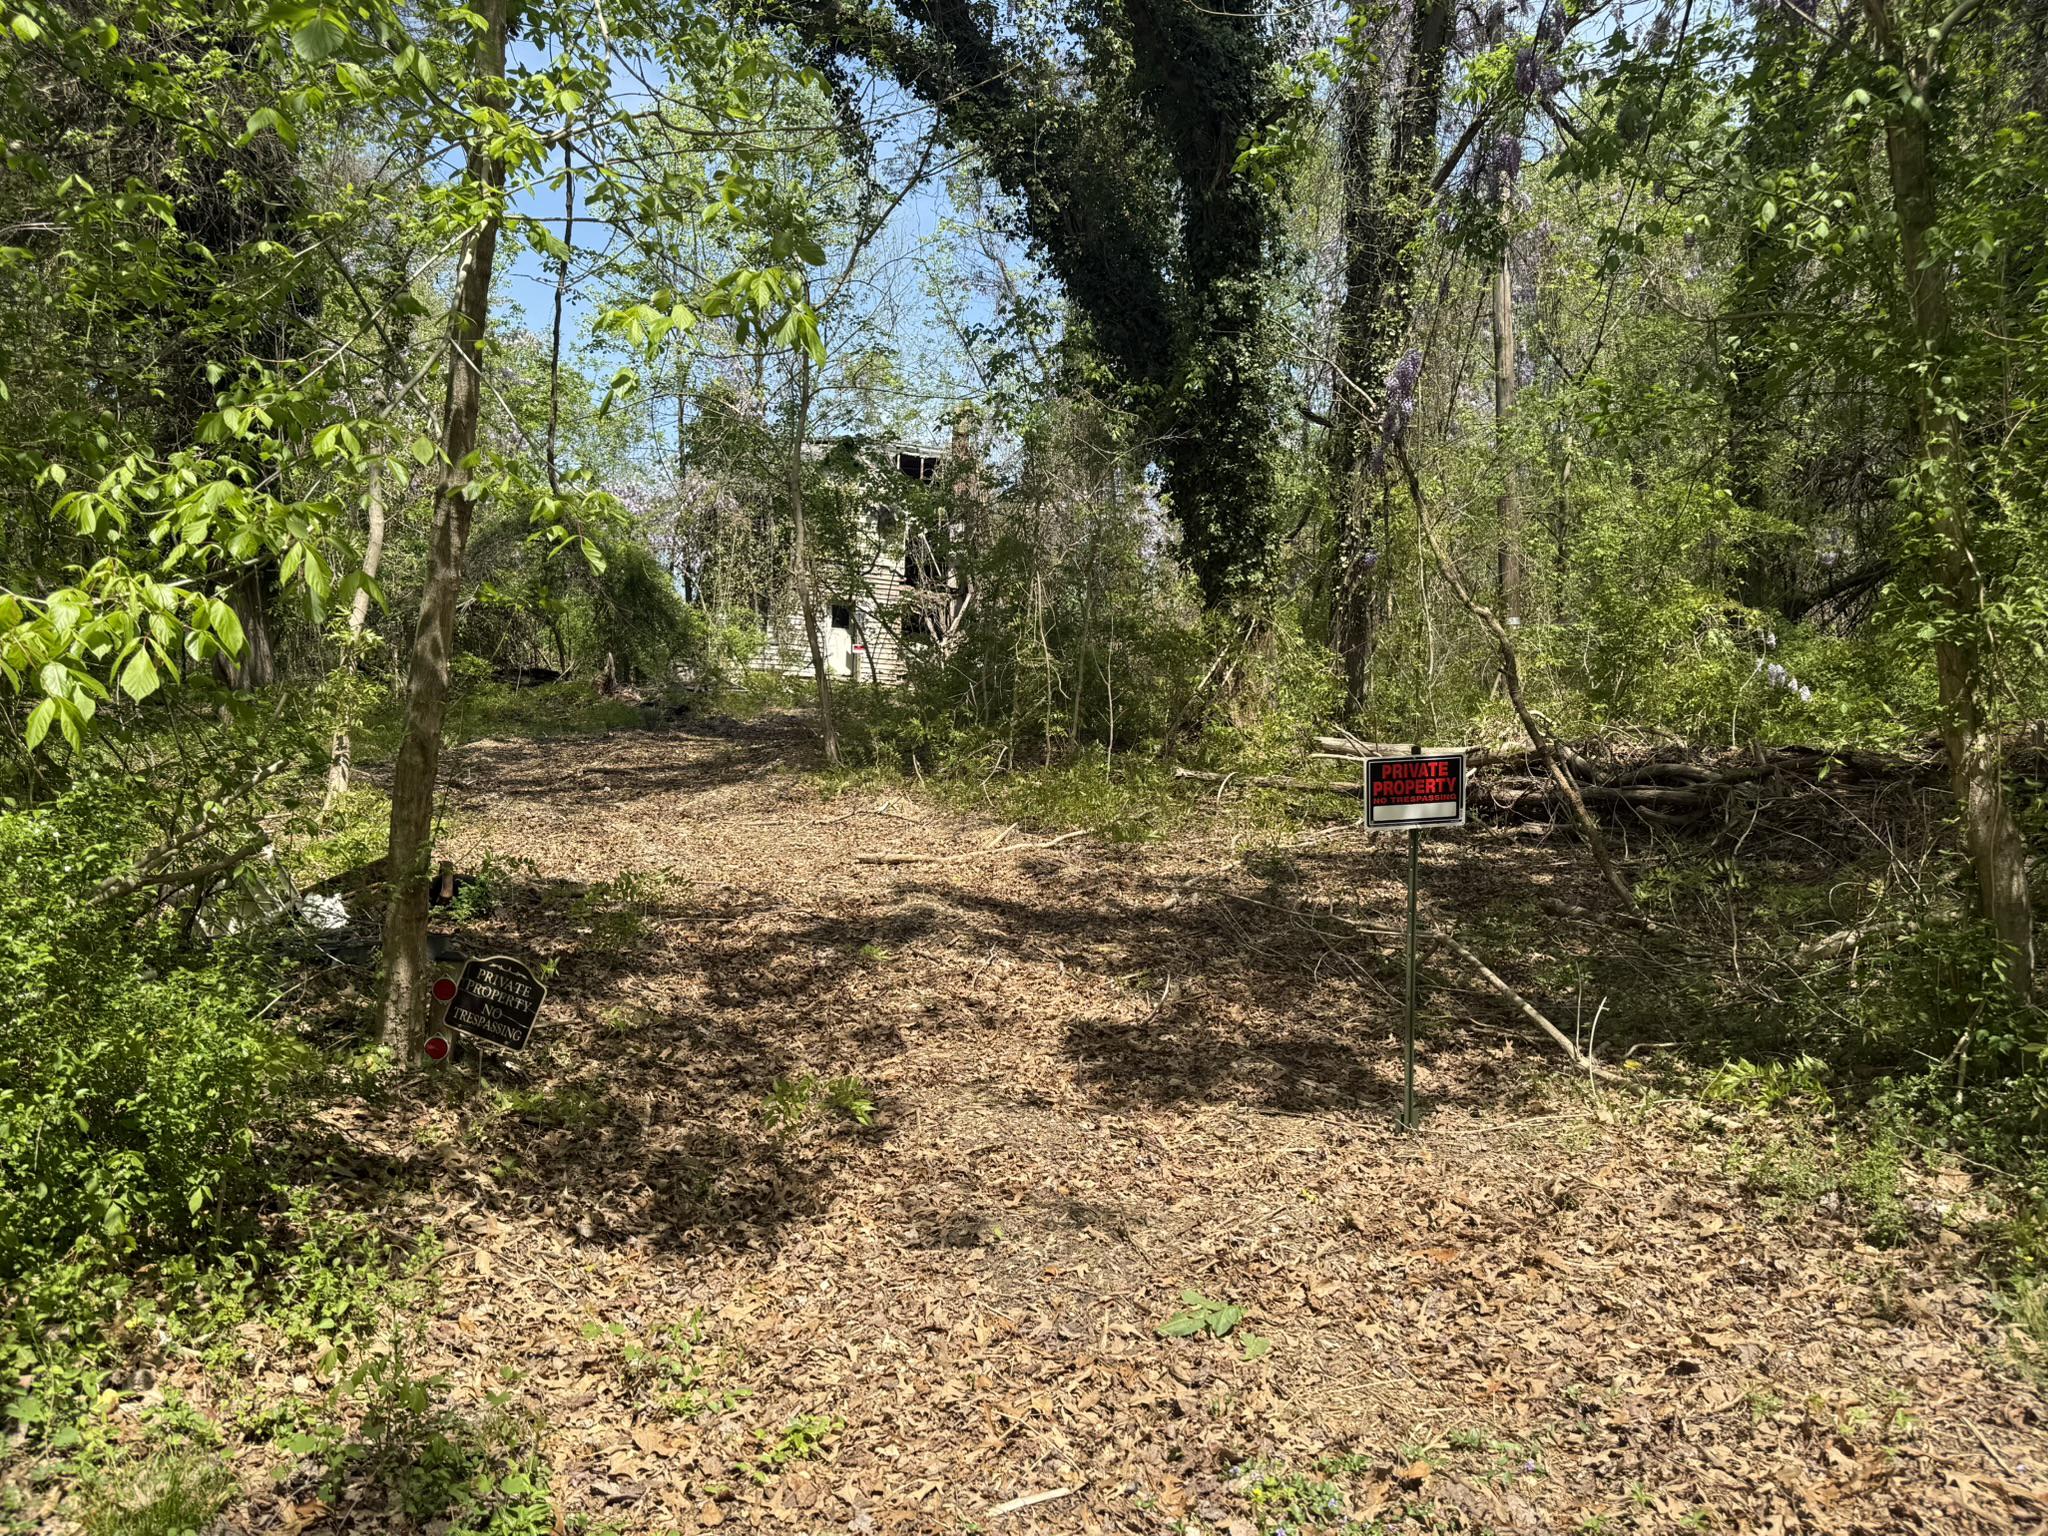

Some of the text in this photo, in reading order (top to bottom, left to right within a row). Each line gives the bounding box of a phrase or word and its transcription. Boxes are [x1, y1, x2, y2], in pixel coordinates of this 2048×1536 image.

[1382, 761, 1449, 779] PRIVATE
[1373, 777, 1457, 796] PROPERTY
[1391, 793, 1457, 803] TRESPASSING
[476, 968, 532, 998] PRIVATE
[465, 979, 532, 1013] PROPERTY
[481, 1003, 503, 1020] NO
[452, 1006, 523, 1041] TRESPASSING
